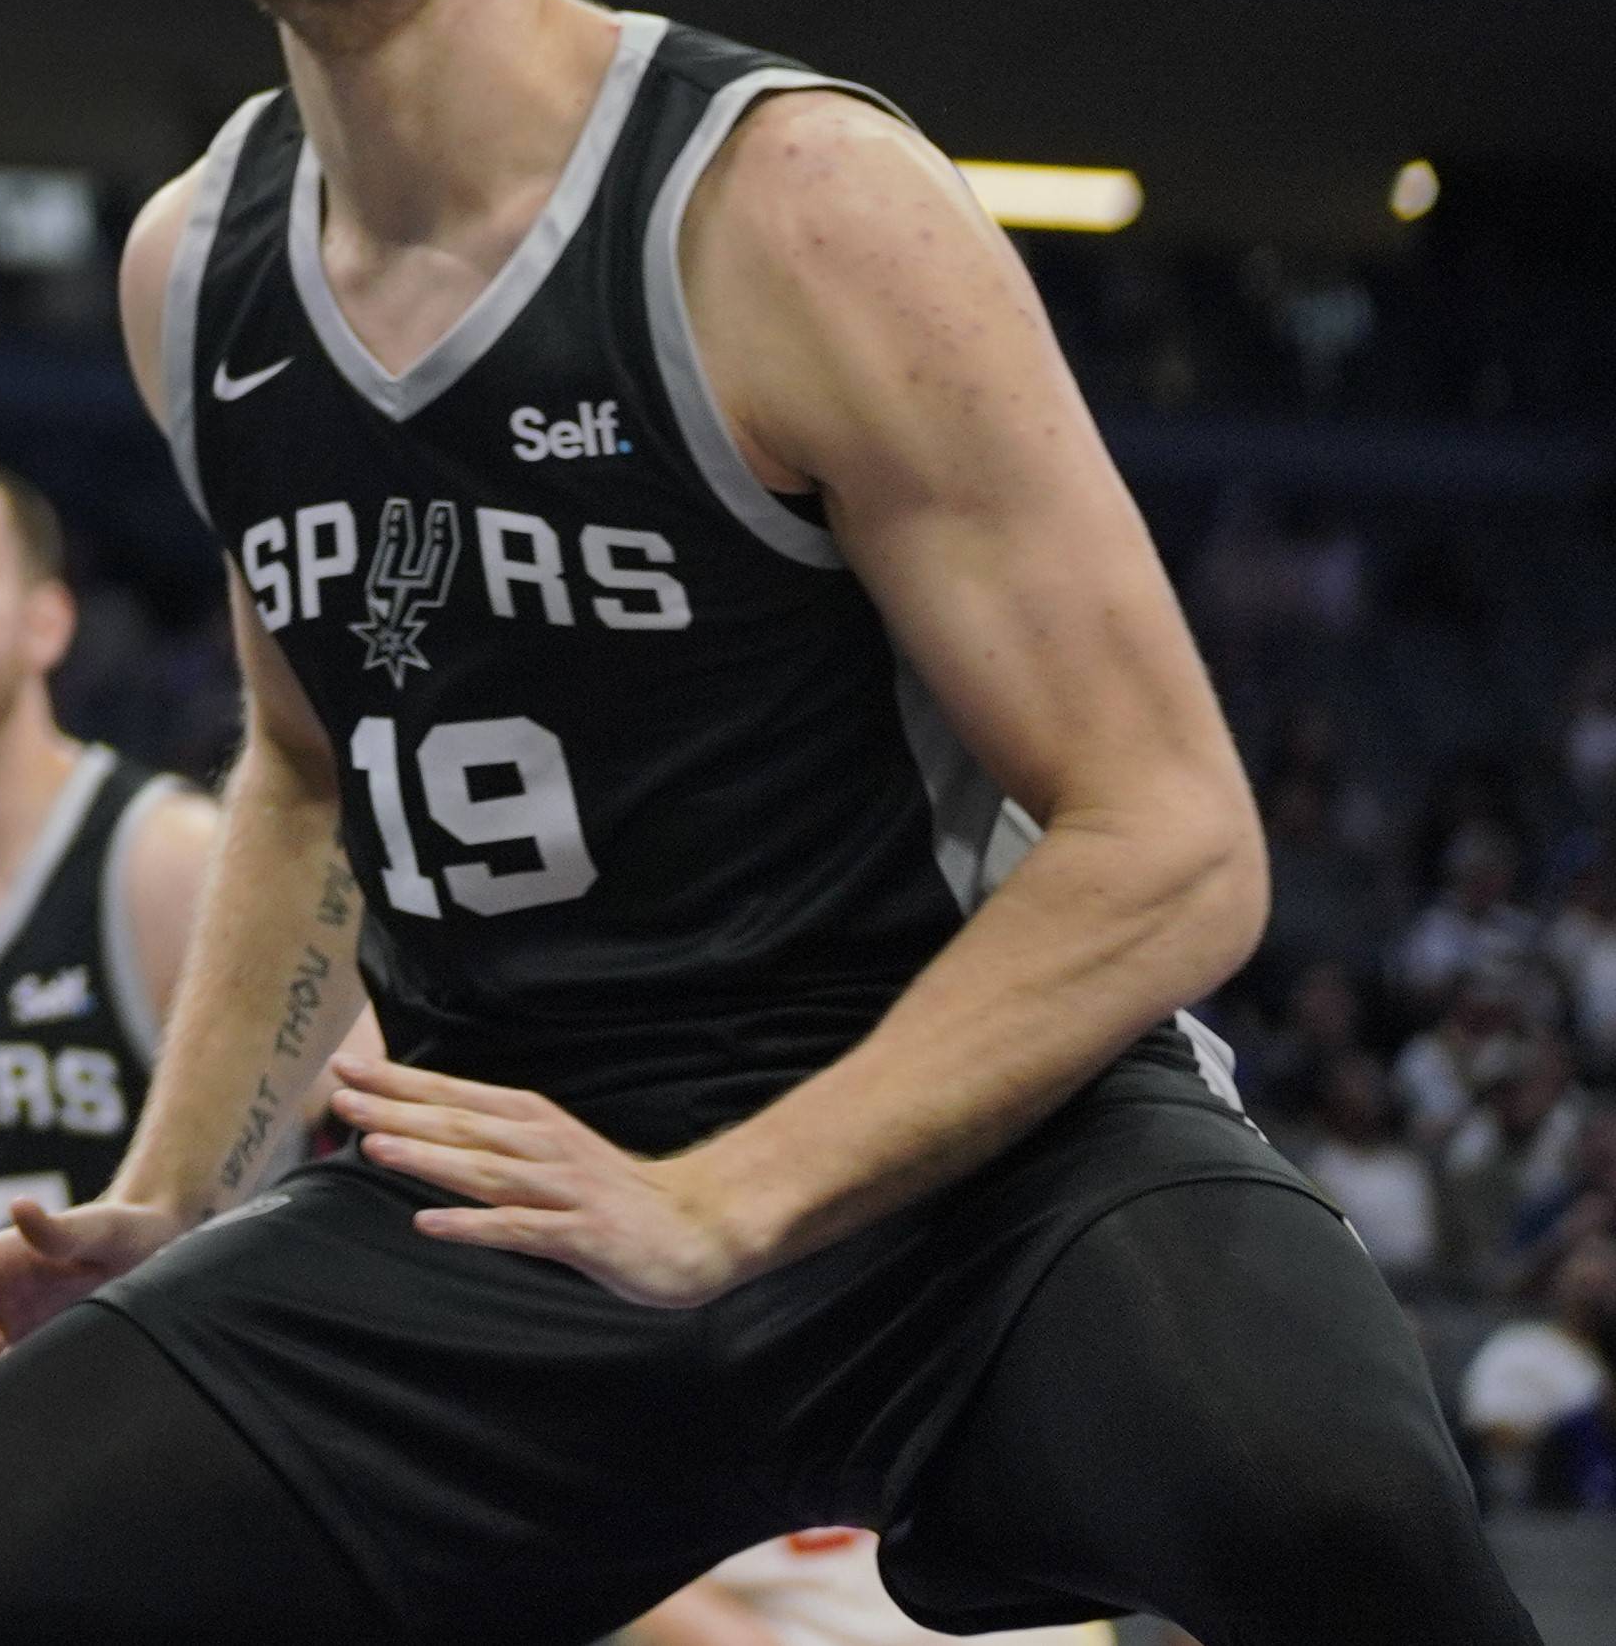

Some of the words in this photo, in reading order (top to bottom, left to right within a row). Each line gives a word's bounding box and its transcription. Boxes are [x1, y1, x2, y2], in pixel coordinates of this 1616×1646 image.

[242, 497, 693, 689] SPURS
[350, 716, 599, 919] 19
[275, 944, 330, 1060] THOU
